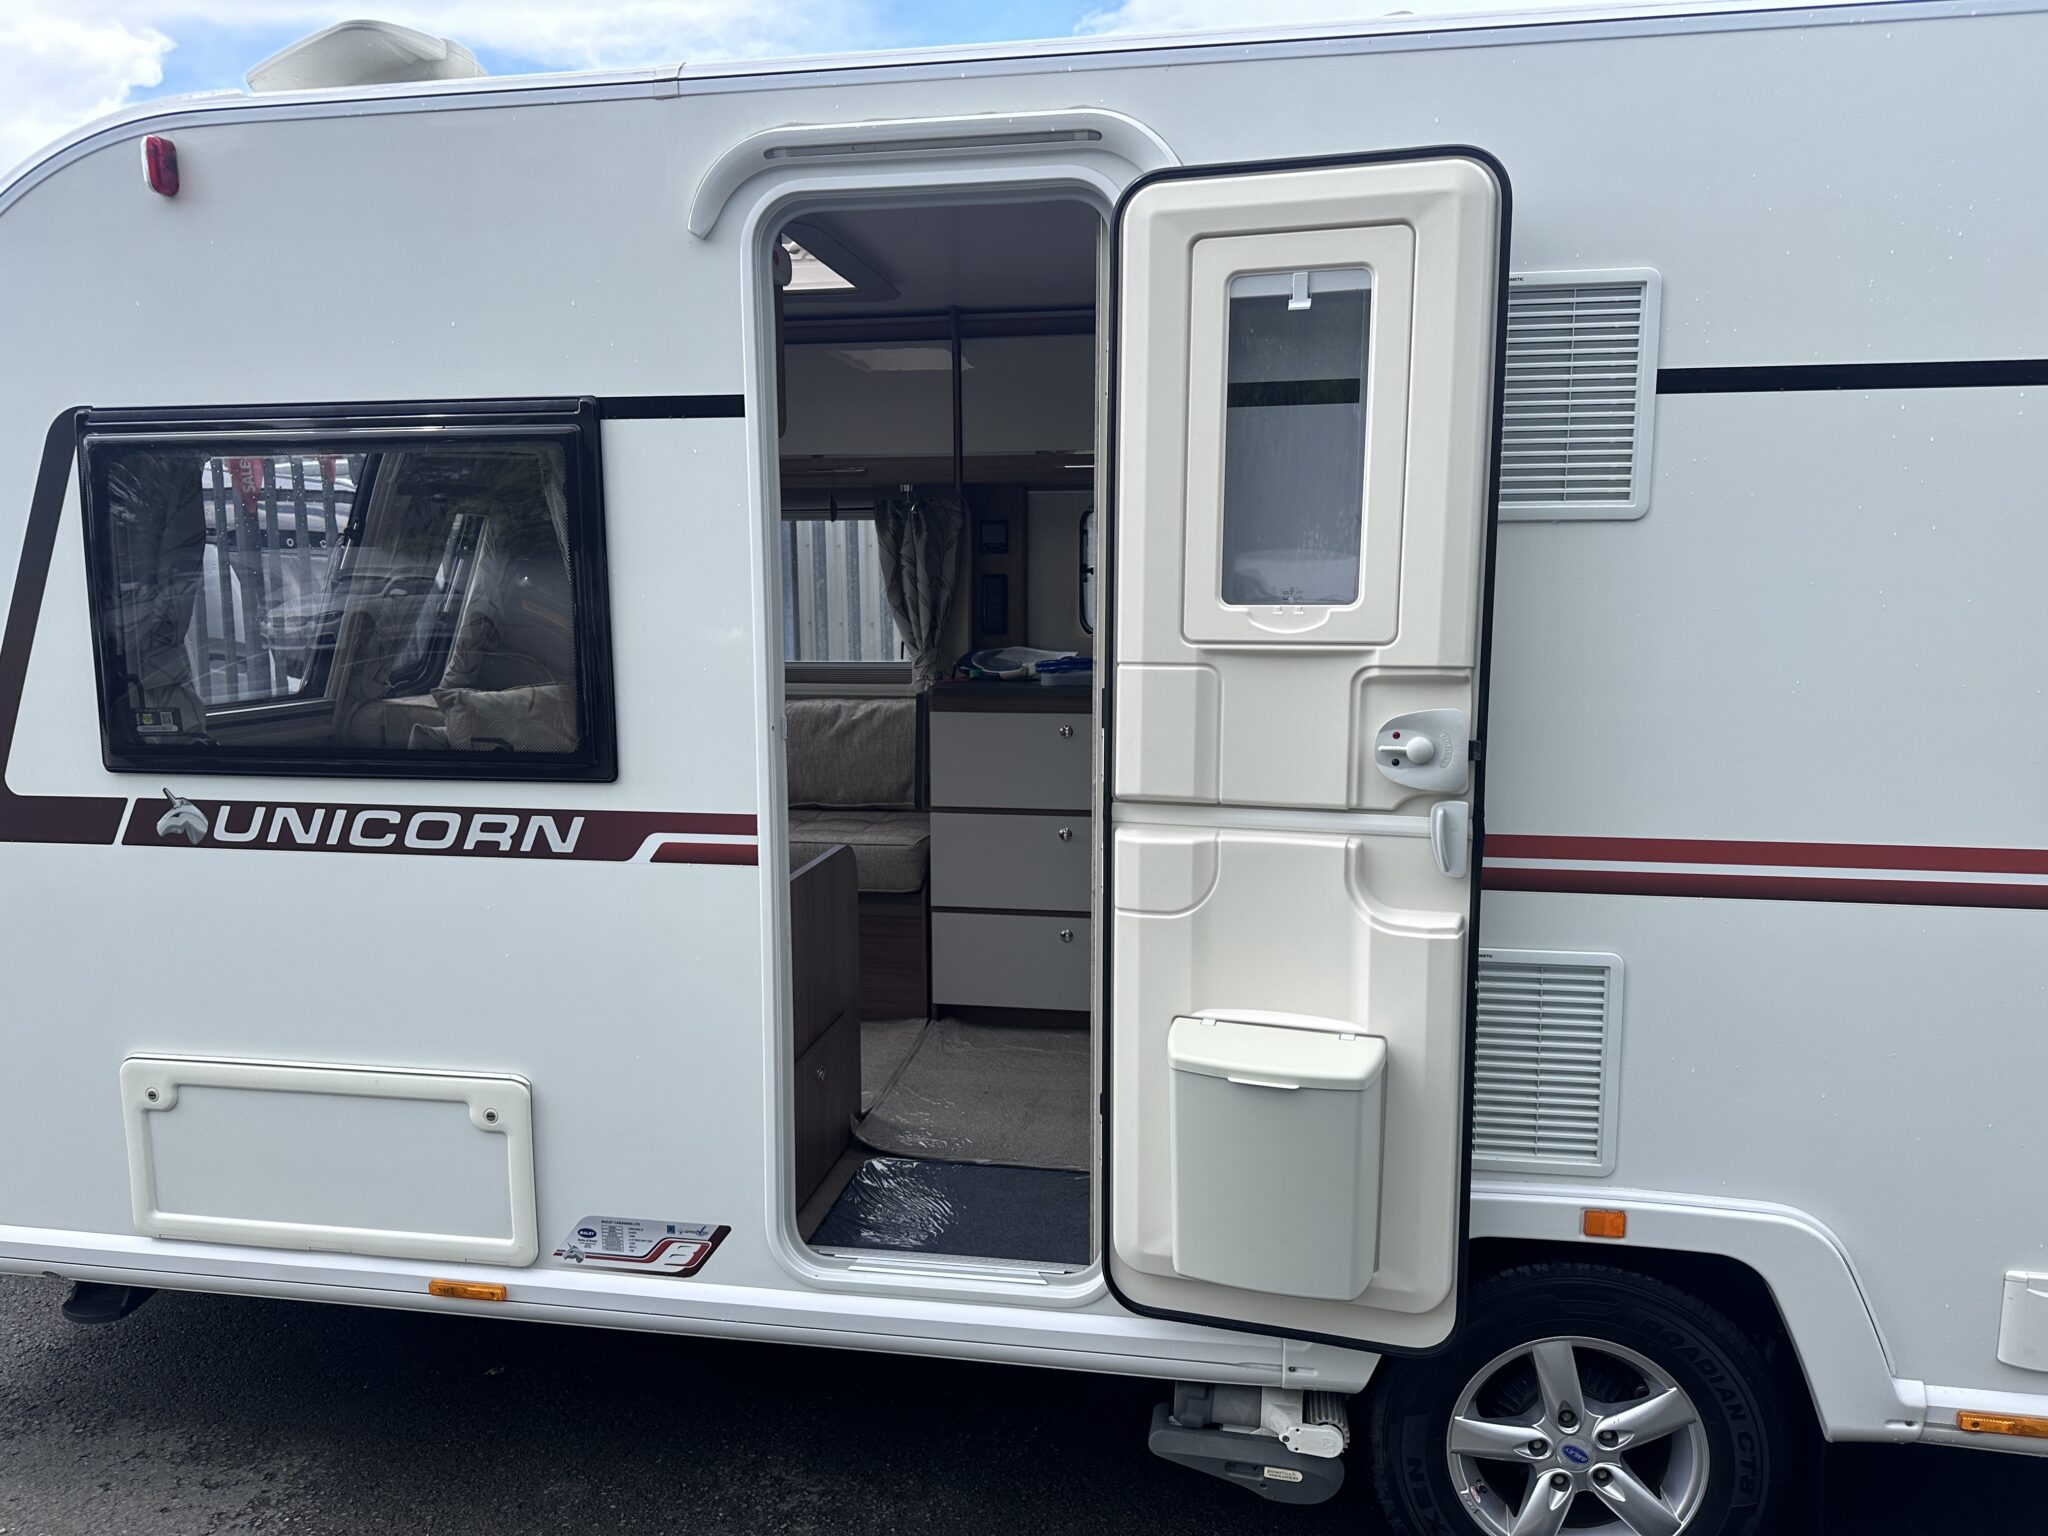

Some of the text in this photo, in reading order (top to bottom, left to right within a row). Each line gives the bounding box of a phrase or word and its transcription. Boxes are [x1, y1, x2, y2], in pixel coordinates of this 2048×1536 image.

[239, 459, 257, 494] SALE
[212, 804, 586, 855] UNICORN
[1639, 1318, 1759, 1495] ROADIAN CT8
